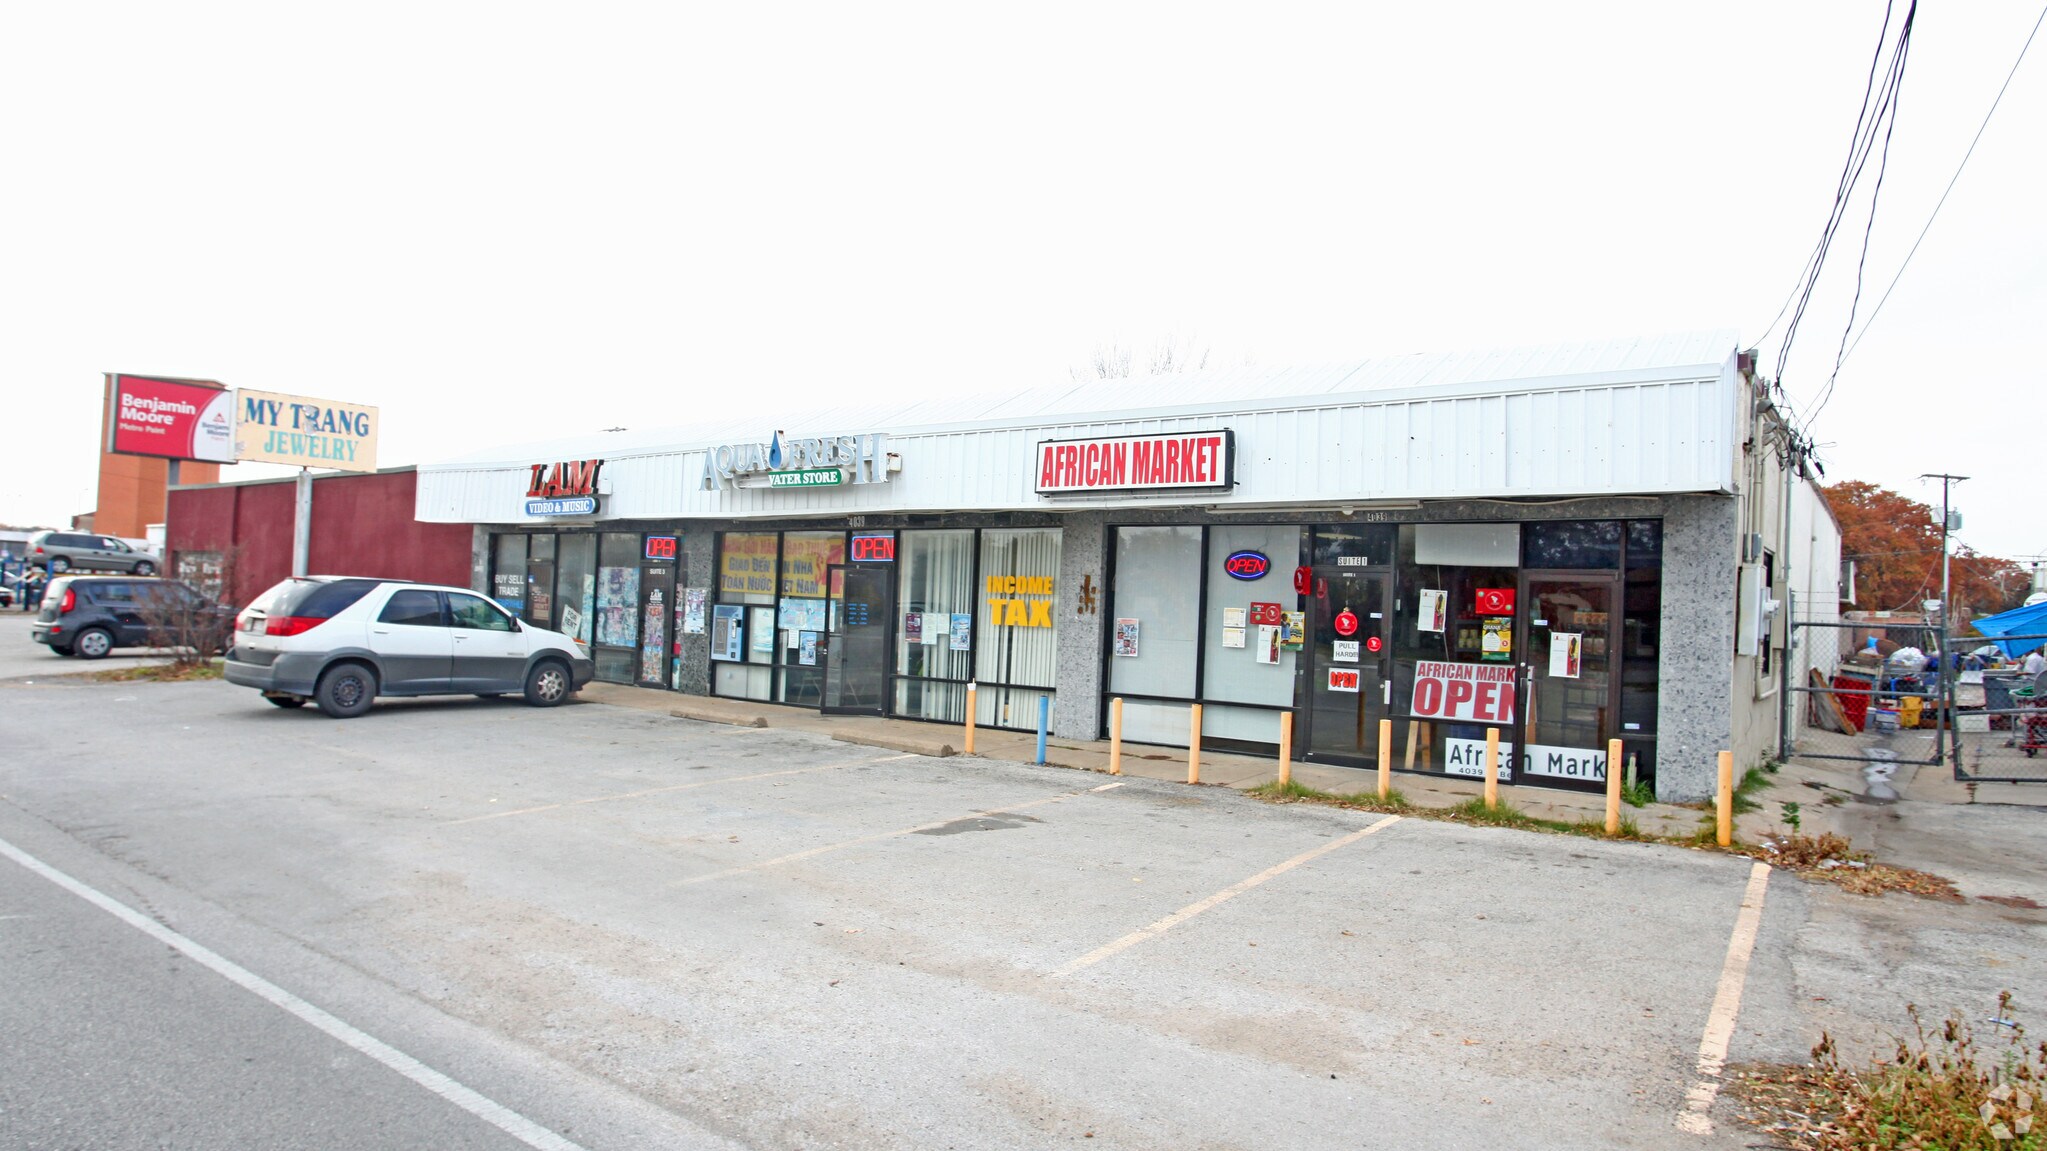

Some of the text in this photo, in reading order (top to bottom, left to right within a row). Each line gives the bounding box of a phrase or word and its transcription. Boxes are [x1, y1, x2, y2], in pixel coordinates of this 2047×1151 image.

[122, 393, 196, 415] Benjamin
[121, 407, 174, 425] Moore
[245, 397, 369, 437] MY TRANG
[119, 423, 166, 435] Metro Paint
[264, 430, 358, 462] JEWELRY
[699, 433, 890, 491] AQUA FRESH
[1040, 436, 1221, 487] AFRICAN MARKET
[803, 471, 838, 484] STORE
[528, 500, 590, 514] VIDEO & MUSIC
[847, 515, 865, 528] 4039
[854, 538, 894, 560] OPEN
[729, 557, 749, 571] GIAO
[1227, 559, 1266, 573] OPEN
[1338, 557, 1360, 565] SUITE
[495, 574, 524, 584] BUY SELL
[986, 575, 1053, 595] INCOME
[498, 586, 519, 596] TRADE
[567, 610, 578, 620] FOR
[987, 598, 1052, 628] TAX
[1330, 671, 1358, 689] OPEN
[1418, 663, 1515, 682] AFRICAN MARK
[1413, 678, 1515, 721] OPEN
[1450, 744, 1531, 771] Afrcan
